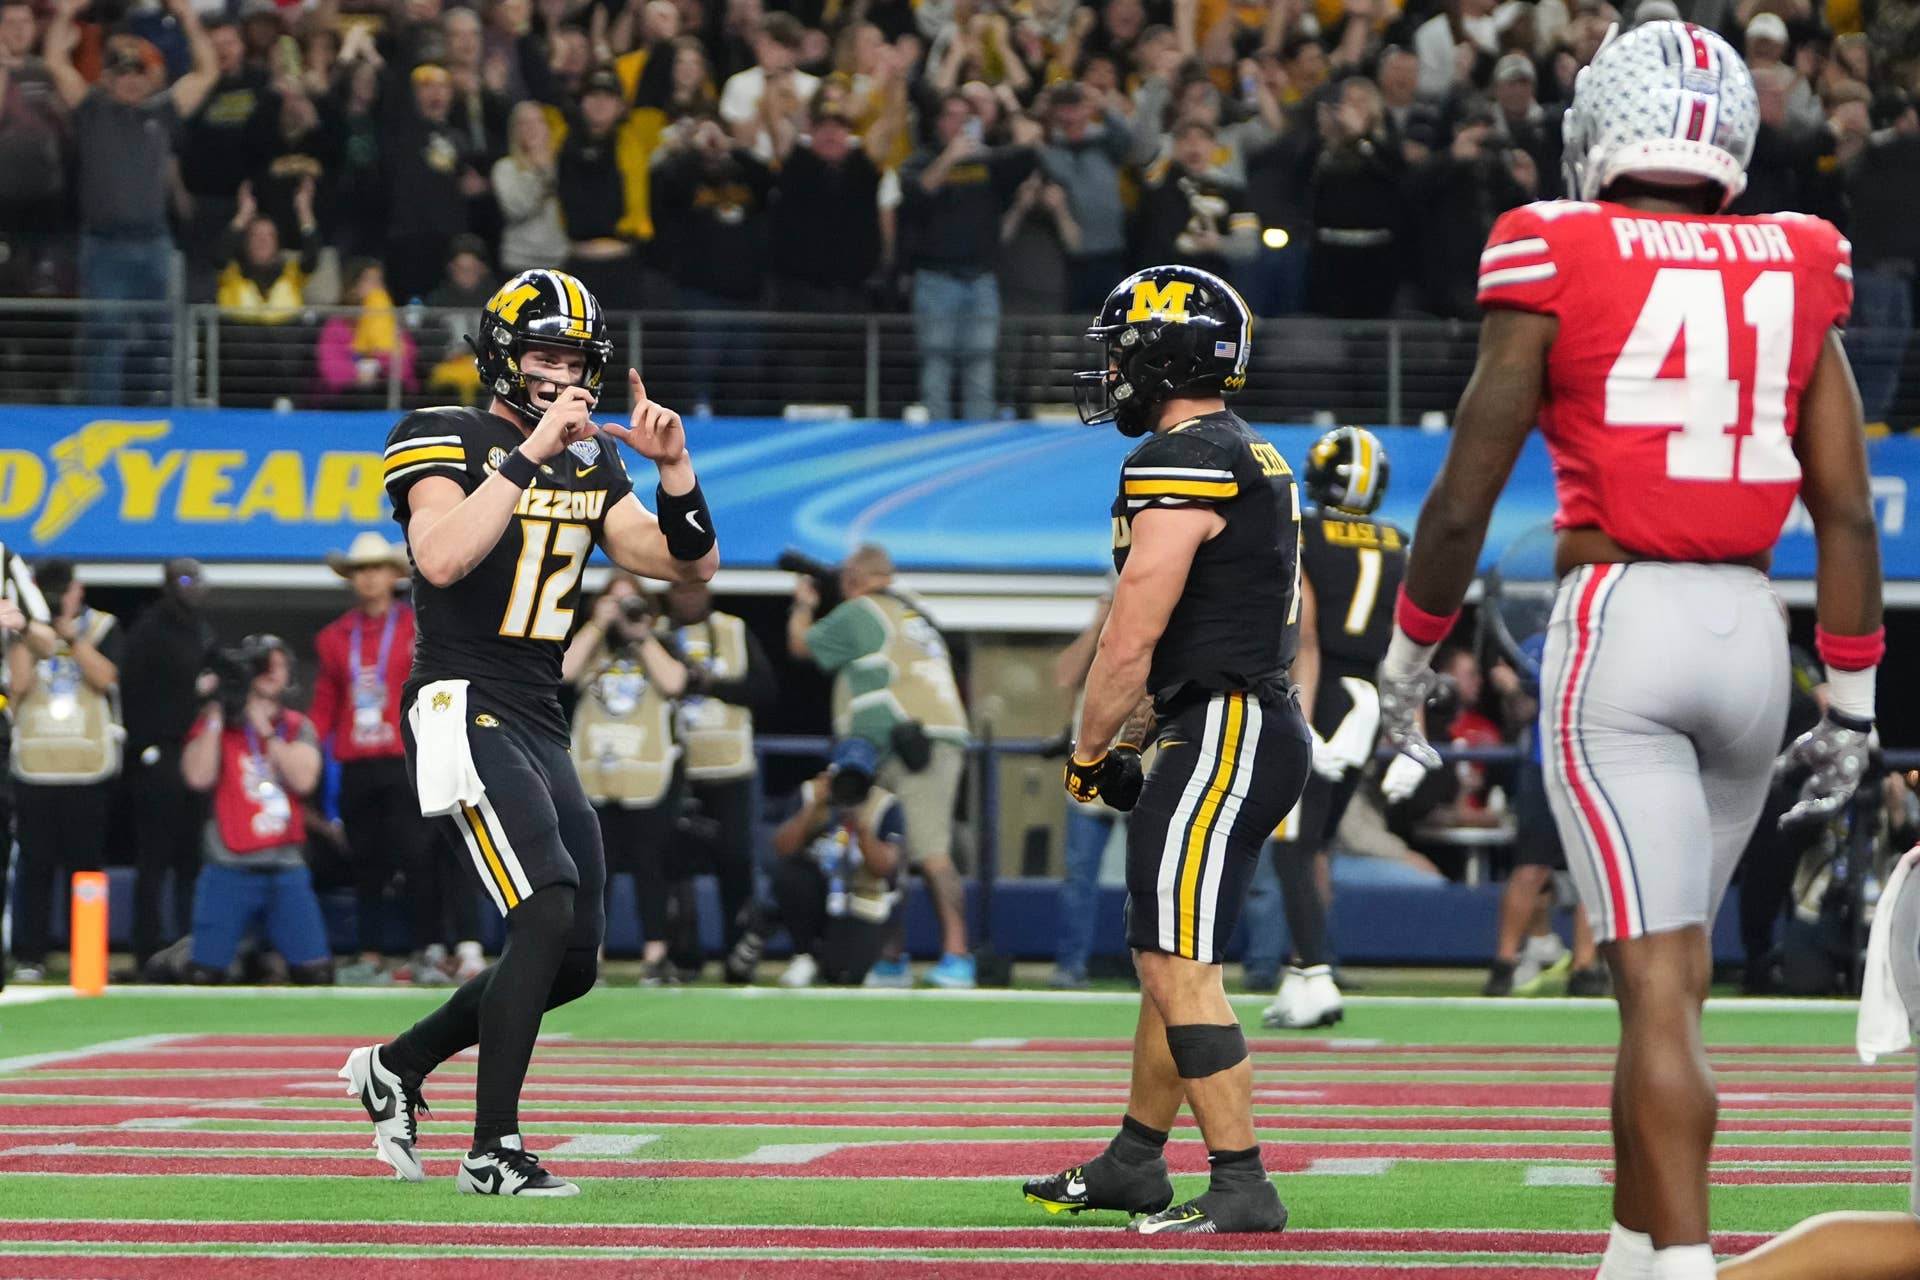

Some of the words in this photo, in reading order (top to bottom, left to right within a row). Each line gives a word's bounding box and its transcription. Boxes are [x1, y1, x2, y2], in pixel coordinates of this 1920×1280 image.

[1611, 217, 1794, 262] PROCTOR
[487, 283, 541, 325] M
[1126, 280, 1195, 324] M
[1604, 267, 1803, 484] 41
[514, 487, 608, 521] IZZOU
[498, 518, 592, 641] 12
[1344, 547, 1382, 636] 1
